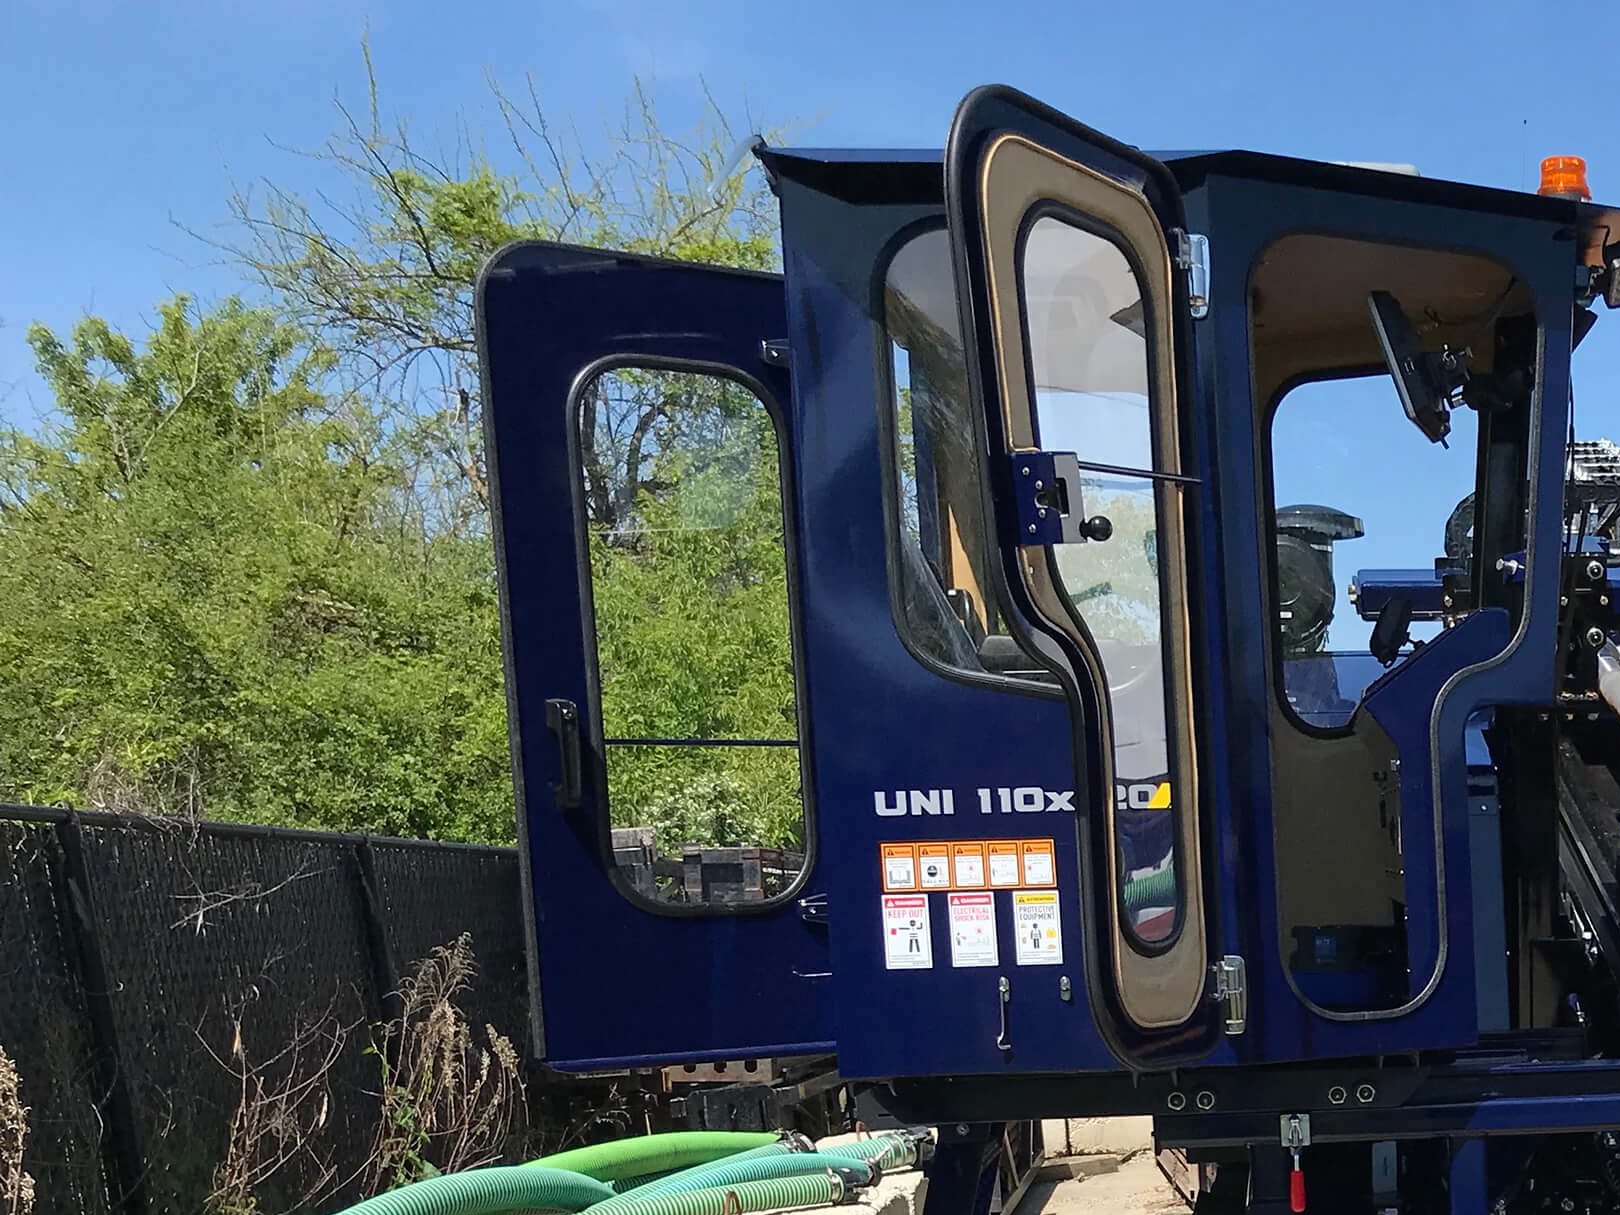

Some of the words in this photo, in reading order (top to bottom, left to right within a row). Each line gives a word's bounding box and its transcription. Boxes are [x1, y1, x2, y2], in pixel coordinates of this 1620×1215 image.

[873, 789, 955, 816] UNI
[887, 909, 907, 919] KEEP
[908, 908, 924, 918] OUT
